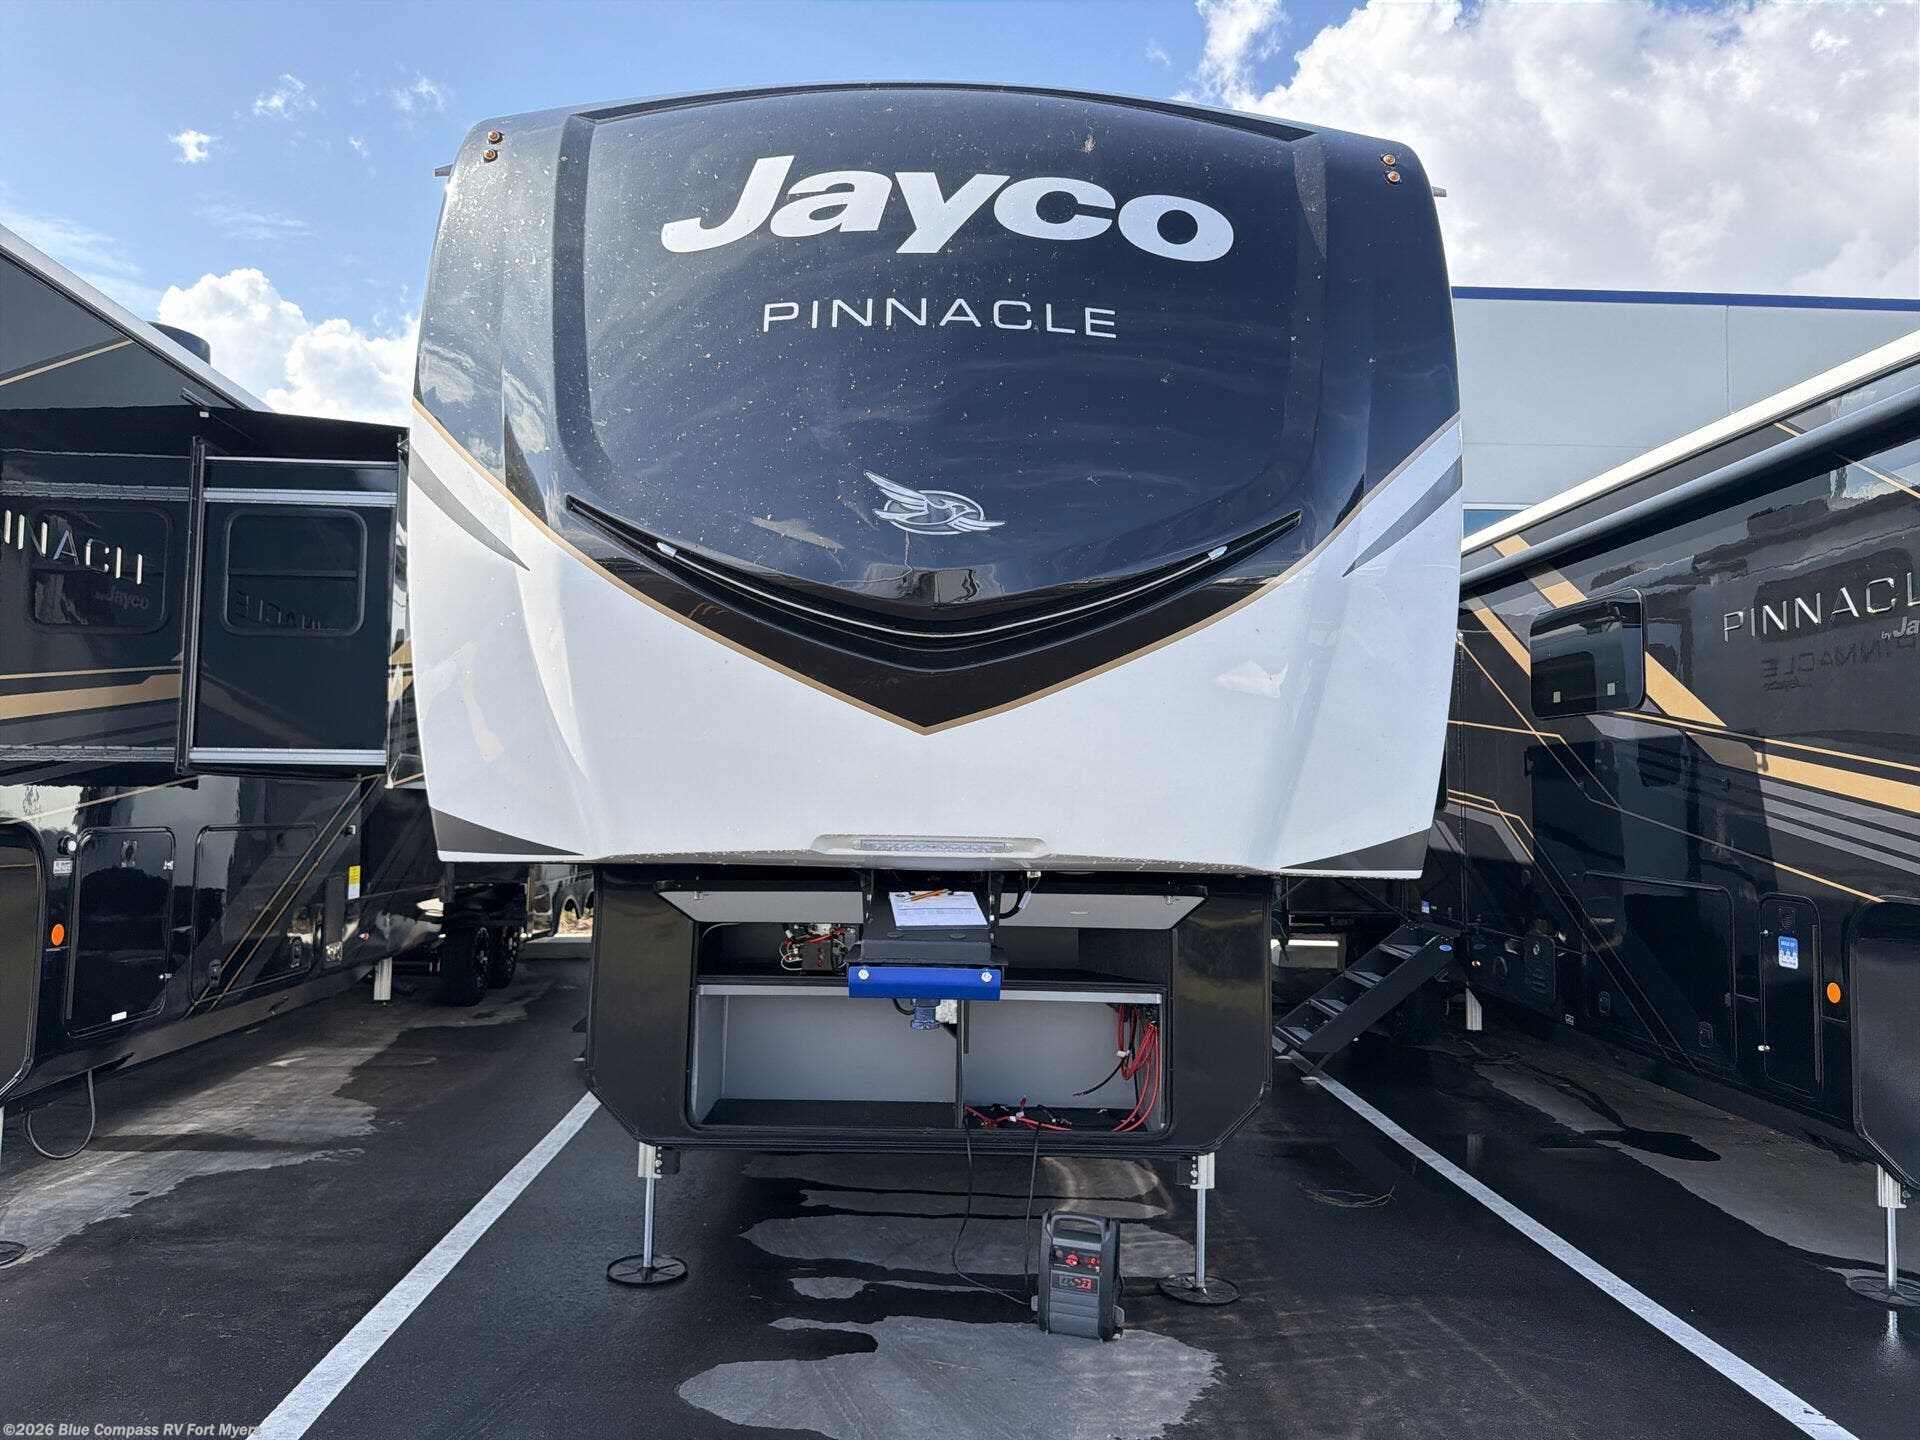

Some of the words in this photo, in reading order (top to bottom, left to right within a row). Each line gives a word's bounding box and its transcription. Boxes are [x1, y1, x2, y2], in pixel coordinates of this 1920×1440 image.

[661, 154, 1235, 263] Jayco
[762, 297, 1118, 339] PINNACLE
[1880, 630, 1892, 641] by
